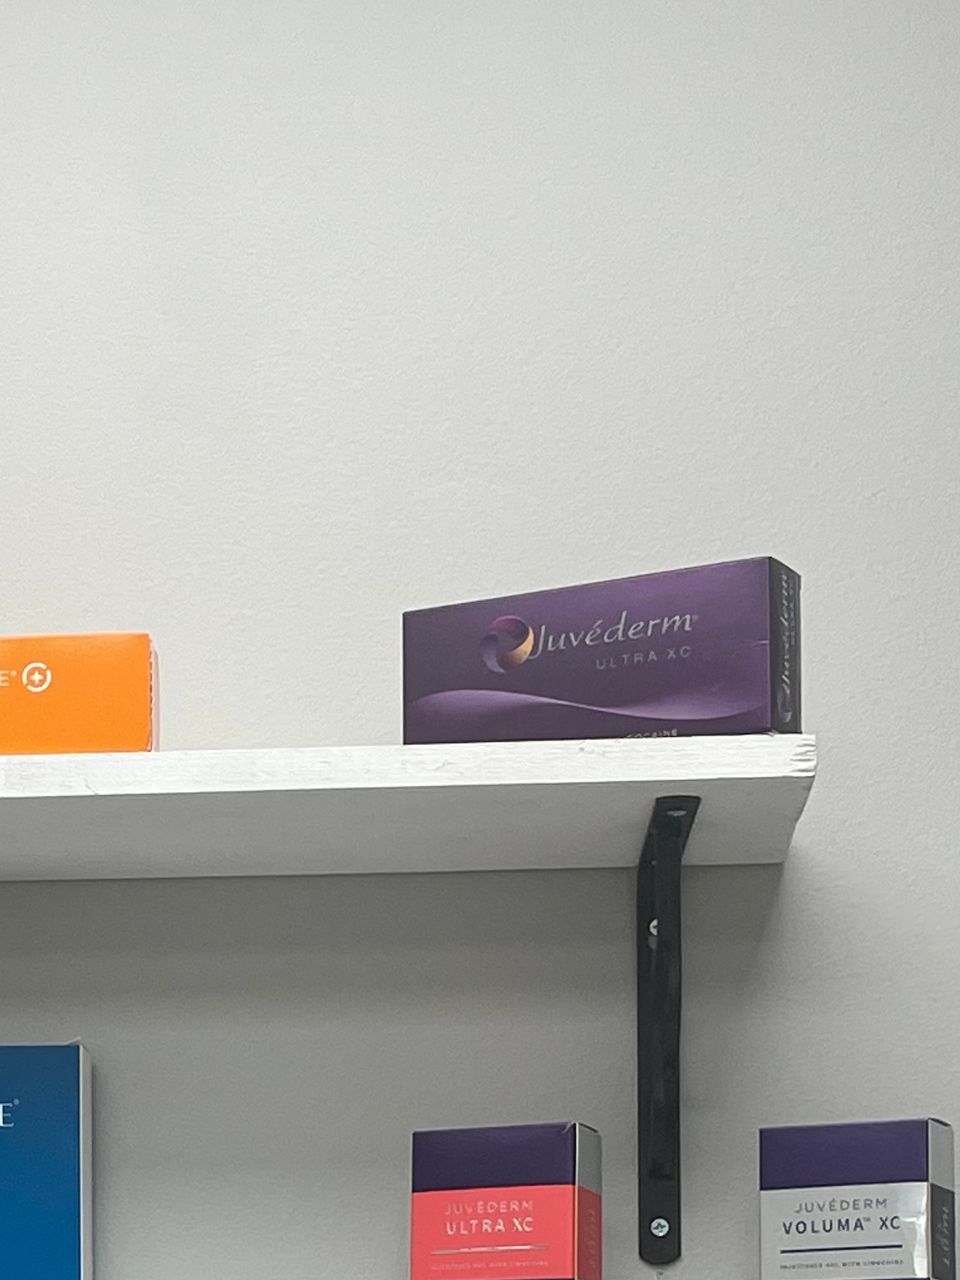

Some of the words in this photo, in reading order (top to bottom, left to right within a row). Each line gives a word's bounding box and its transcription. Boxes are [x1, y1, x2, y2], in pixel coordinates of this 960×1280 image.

[526, 610, 693, 660] Juvéderm
[596, 648, 658, 670] ULTRA
[668, 646, 692, 660] XC
[794, 1198, 888, 1214] JUVÉDERM
[446, 1218, 506, 1235] ULTRA
[512, 1217, 534, 1232] XC
[879, 1216, 901, 1230] XC
